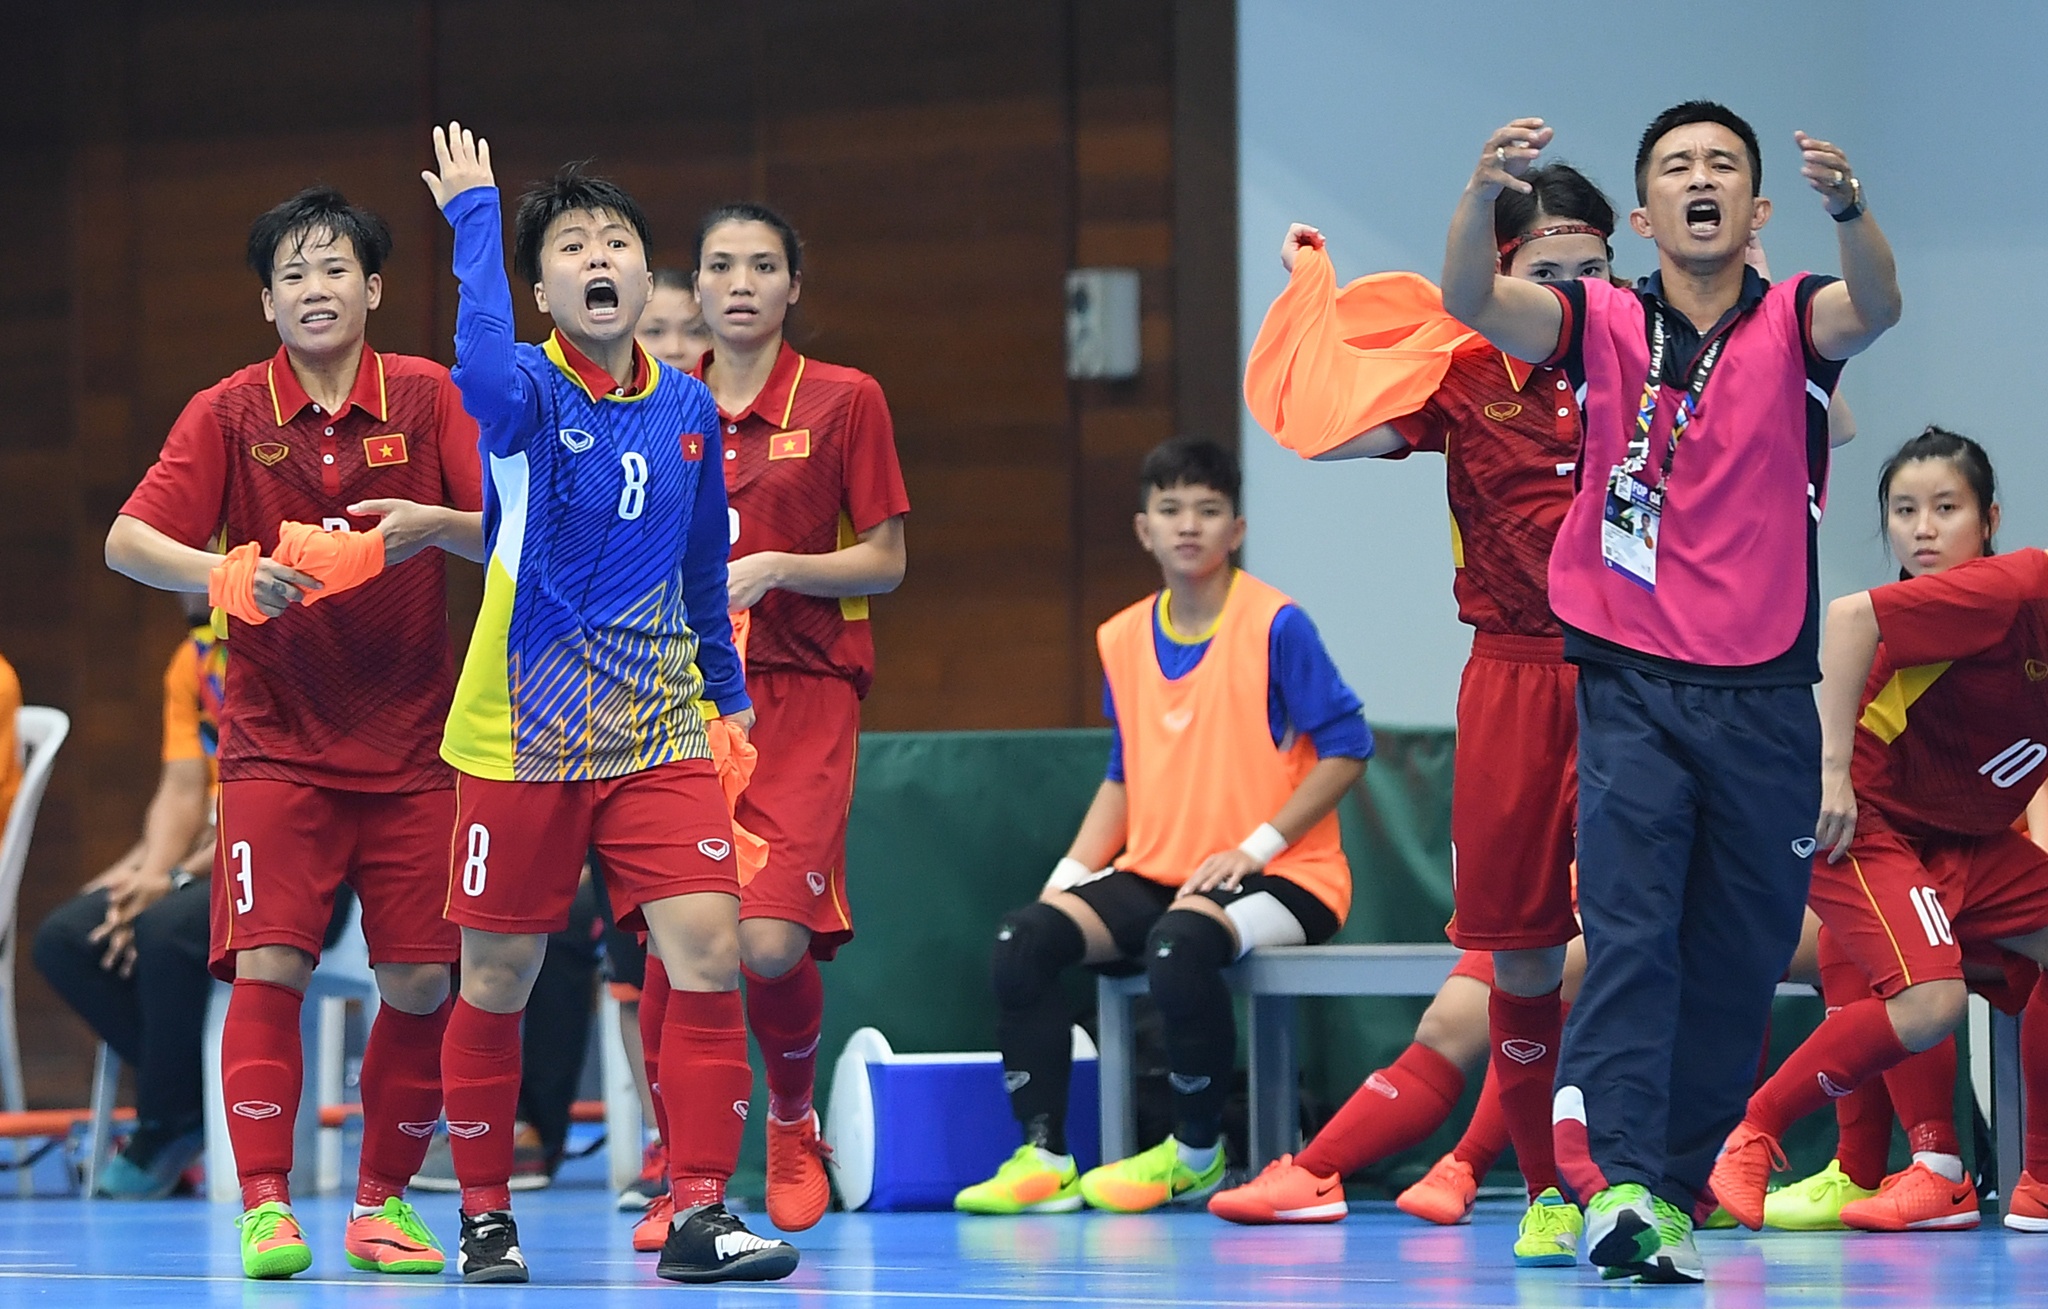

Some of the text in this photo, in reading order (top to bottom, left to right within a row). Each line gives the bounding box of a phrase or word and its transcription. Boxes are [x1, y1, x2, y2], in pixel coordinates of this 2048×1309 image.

[618, 451, 649, 520] 8
[1978, 738, 2048, 788] 10
[232, 840, 254, 915] 3
[462, 823, 490, 897] 8
[1909, 885, 1954, 946] 10
